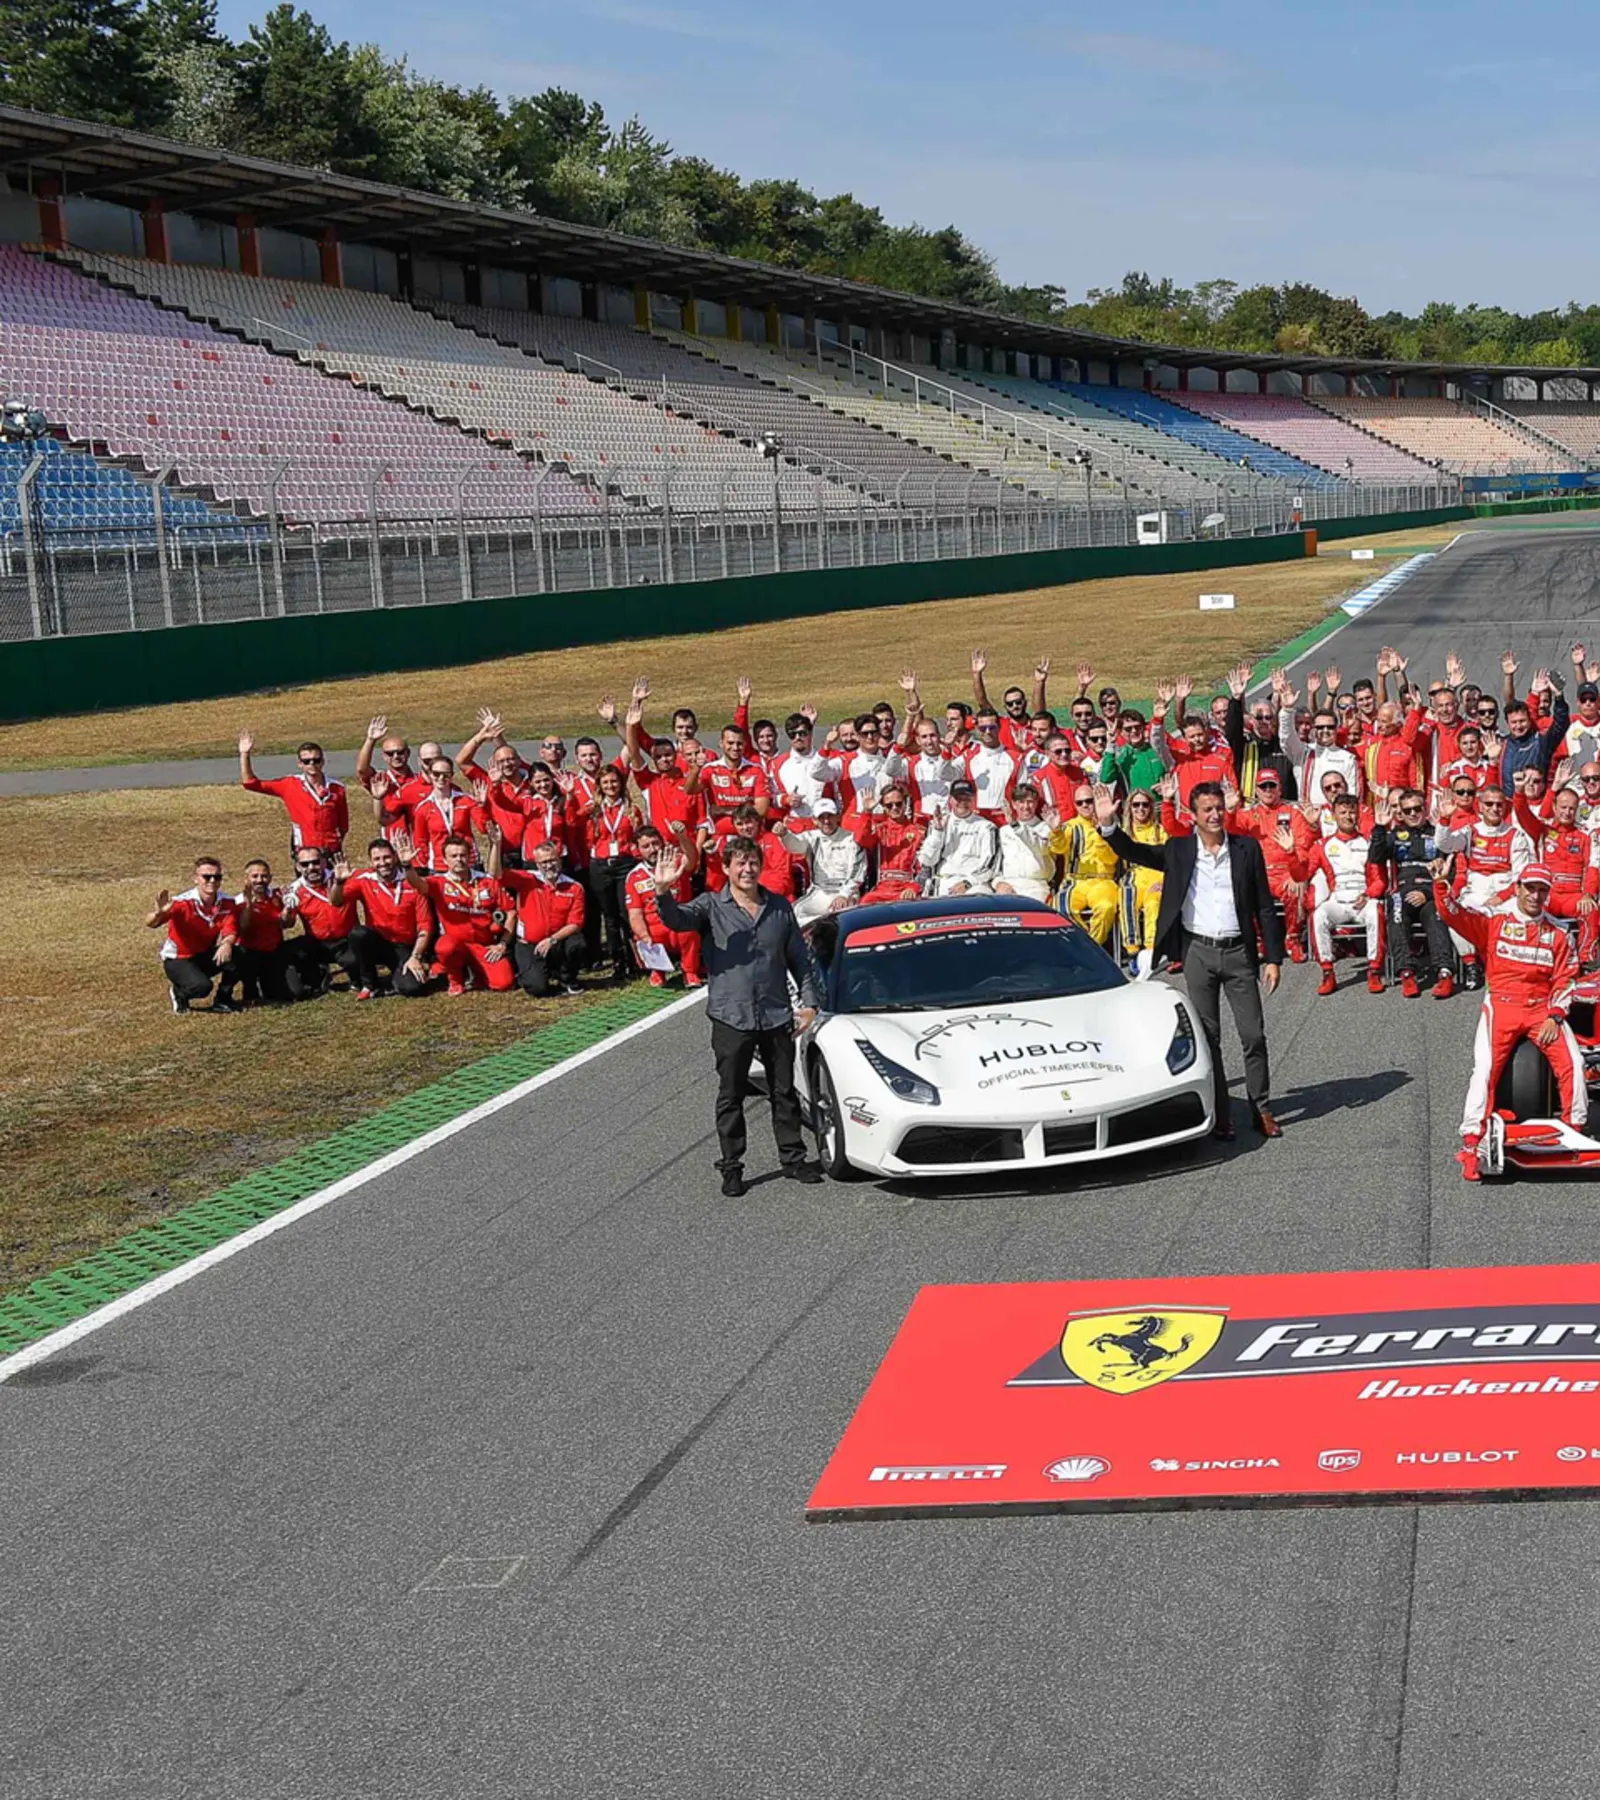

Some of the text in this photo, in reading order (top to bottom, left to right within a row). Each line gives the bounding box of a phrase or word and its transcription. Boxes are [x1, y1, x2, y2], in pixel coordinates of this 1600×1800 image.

[978, 1040, 1103, 1068] HUBLOT
[977, 1060, 1125, 1090] OFFICIAL TIMEKEEPER
[1183, 1457, 1281, 1471] SINGHA
[1321, 1456, 1357, 1468] ups
[1395, 1449, 1520, 1465] HUBLOT
[867, 1464, 1008, 1481] PIRELLI
